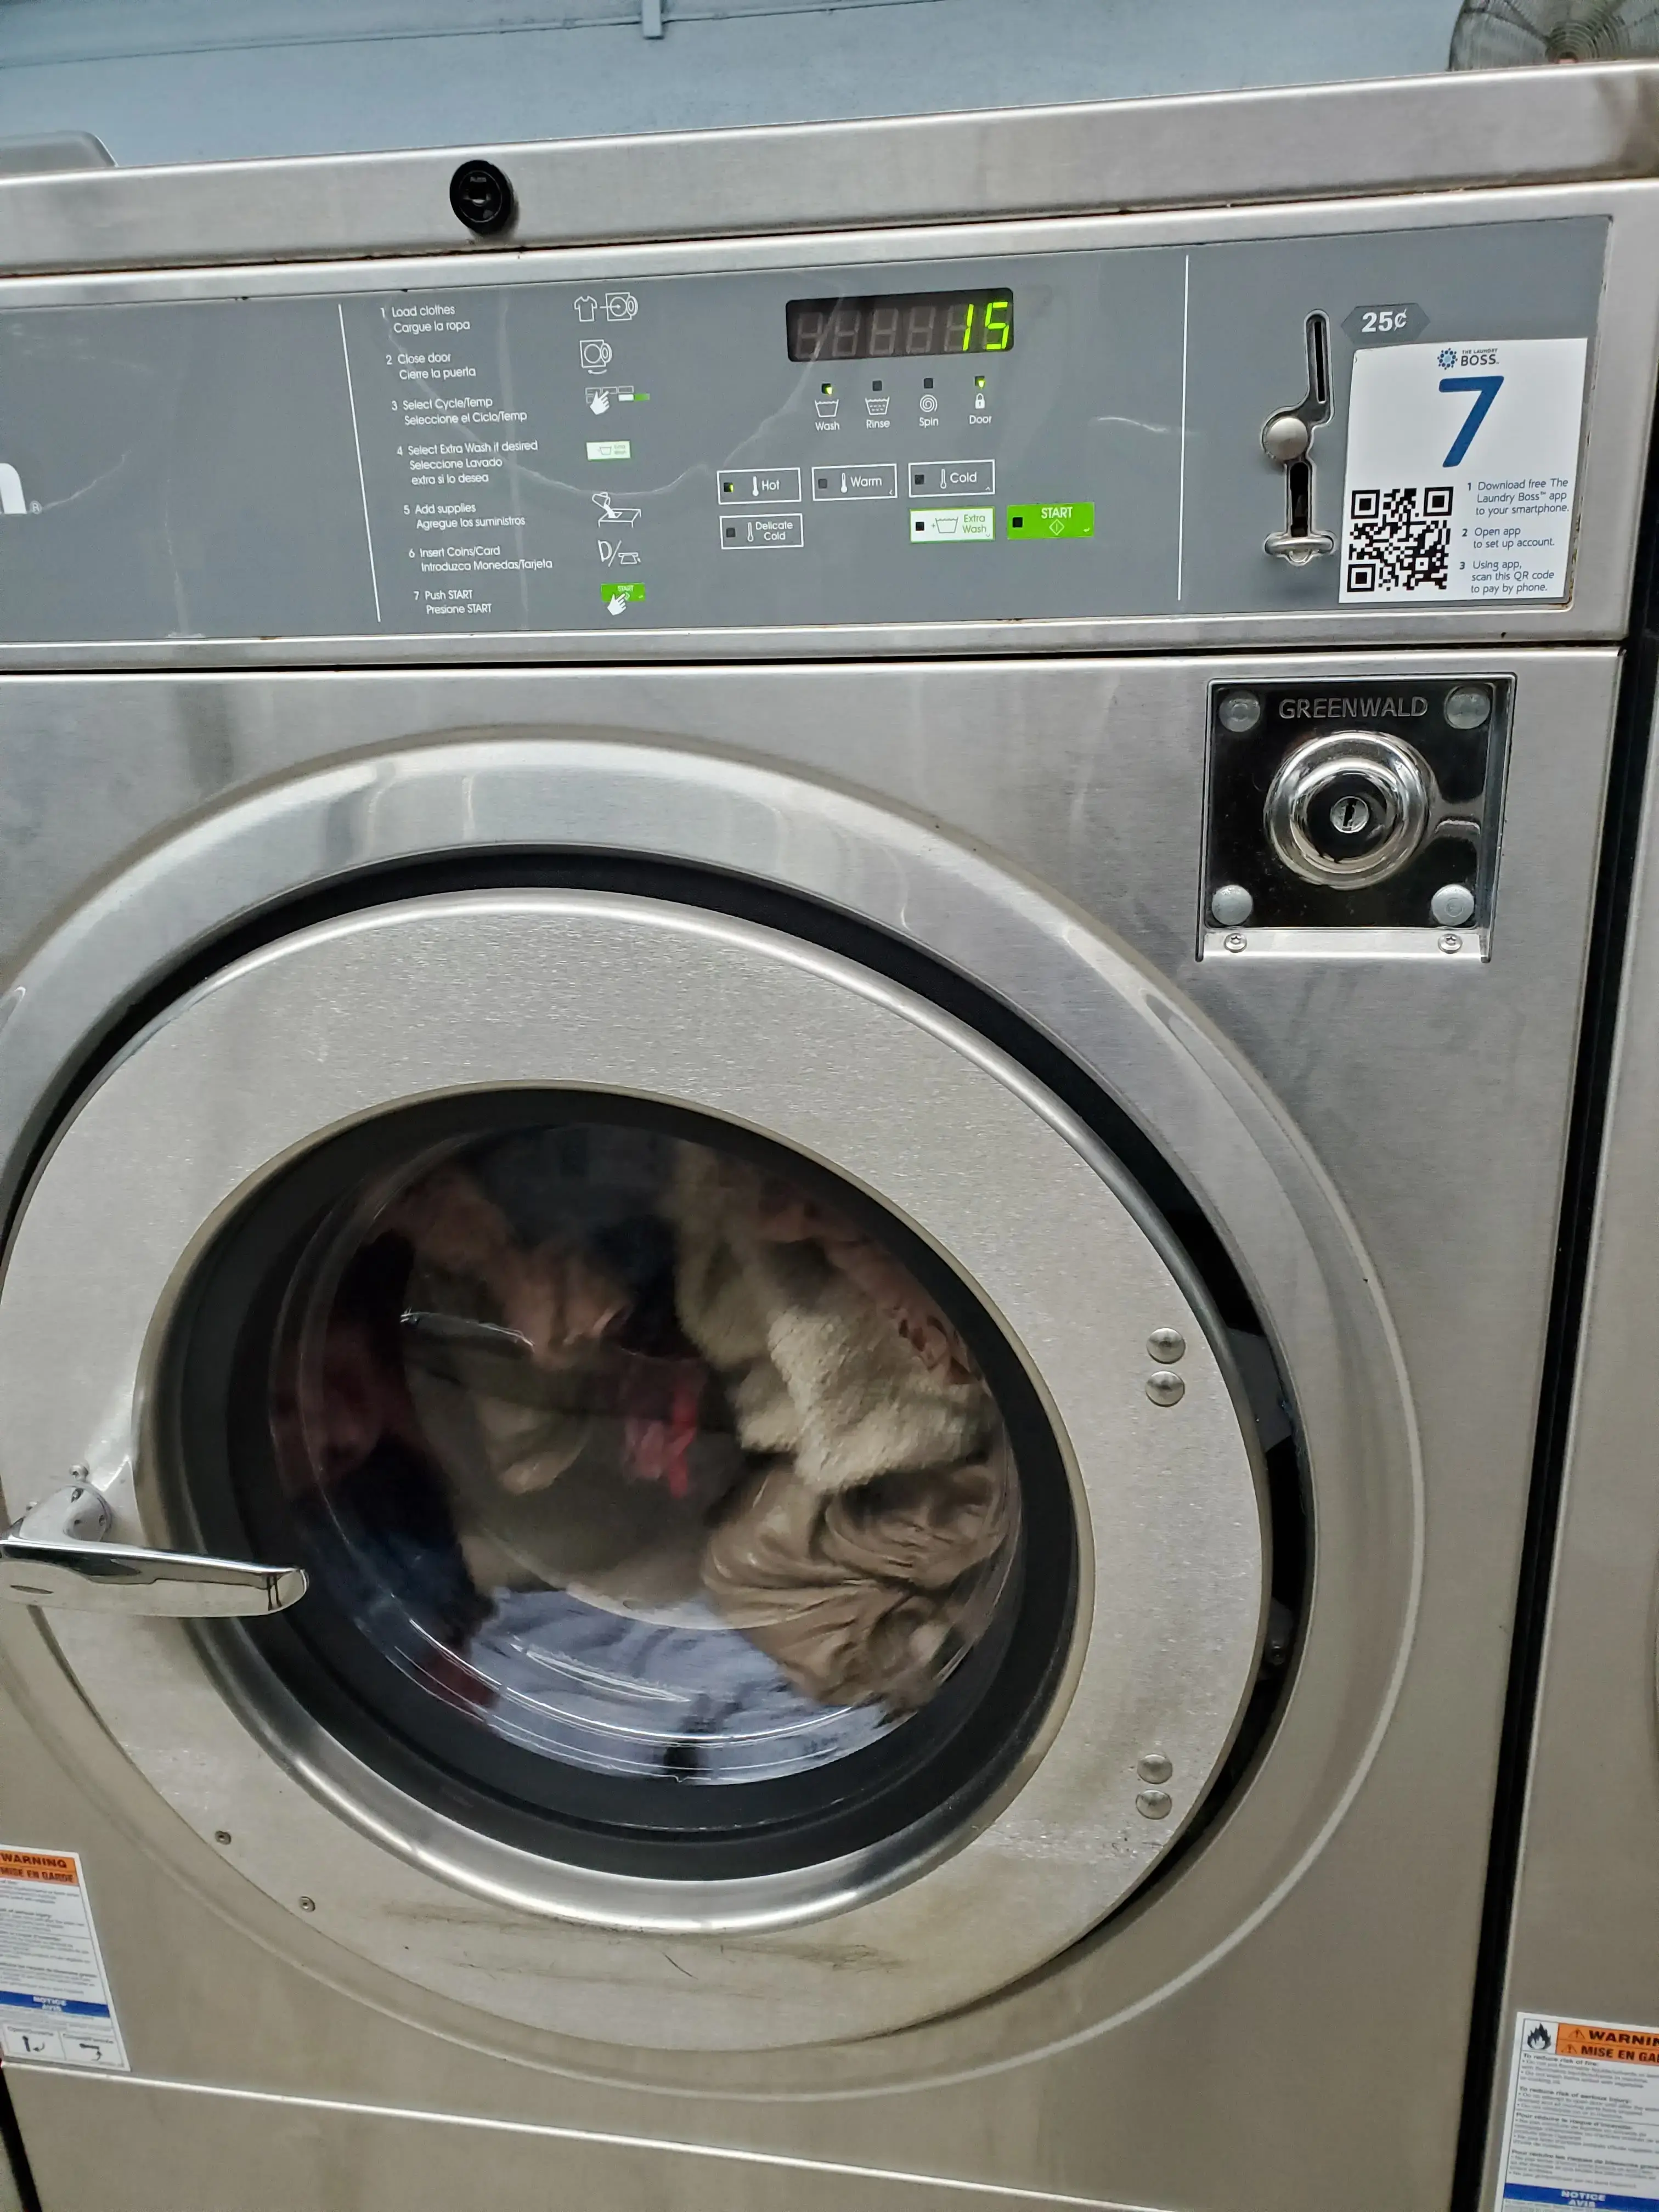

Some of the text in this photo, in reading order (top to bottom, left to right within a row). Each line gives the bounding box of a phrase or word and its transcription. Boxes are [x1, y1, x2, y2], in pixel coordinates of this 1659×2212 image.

[380, 304, 455, 318] 1 Load clothes
[962, 301, 1008, 351] 15
[1362, 309, 1407, 332] 25¢
[393, 320, 470, 335] Cargue la ropa
[386, 352, 451, 365] 2 Close door
[399, 366, 476, 380] Cierre la puerta
[392, 397, 493, 410] 3 Select Cycle/Temp
[404, 411, 527, 425] Seleccione el Ciclo/Temp
[866, 418, 890, 430] Rinse
[919, 415, 939, 428] Spin
[969, 414, 992, 425] Door
[1438, 375, 1504, 468] 7
[815, 420, 840, 432] Wash
[397, 441, 538, 456] 4 Select Extra Wash if desired
[410, 458, 503, 471] Seleccione Lavado
[411, 473, 489, 485] extra si lo desea
[850, 476, 882, 488] Warm
[950, 472, 977, 484] Cold
[761, 479, 780, 491] Hot
[1468, 478, 1568, 491] 1 Download free The
[1477, 493, 1515, 505] Laundry
[1549, 493, 1567, 503] app
[404, 503, 476, 515] 5 Add supplies
[1041, 506, 1073, 519] START
[1476, 504, 1569, 518] to your smartphone.
[416, 516, 526, 531] Agregue los suministros
[963, 513, 986, 524] Extra
[755, 520, 794, 532] Delicate
[962, 523, 987, 534] Wash
[764, 530, 786, 541] Cold
[1462, 527, 1521, 539] 2 Open app
[1474, 538, 1555, 550] to set up account.
[409, 546, 500, 558] 6 Insert Coins/Card
[421, 558, 552, 572] Introduzca Monedas/Tarjeta
[1459, 560, 1522, 572] 3 Using app,
[1471, 570, 1554, 582] scan this QR code
[414, 589, 472, 601] 7 Push START
[1471, 583, 1548, 595] to pay by phone.
[426, 603, 492, 614] Presione START
[1279, 696, 1427, 719] GREENWALD
[0, 1853, 67, 1868] WARNING
[1582, 2045, 1659, 2064] MISE EN GA
[1561, 2191, 1606, 2201] NOTICE
